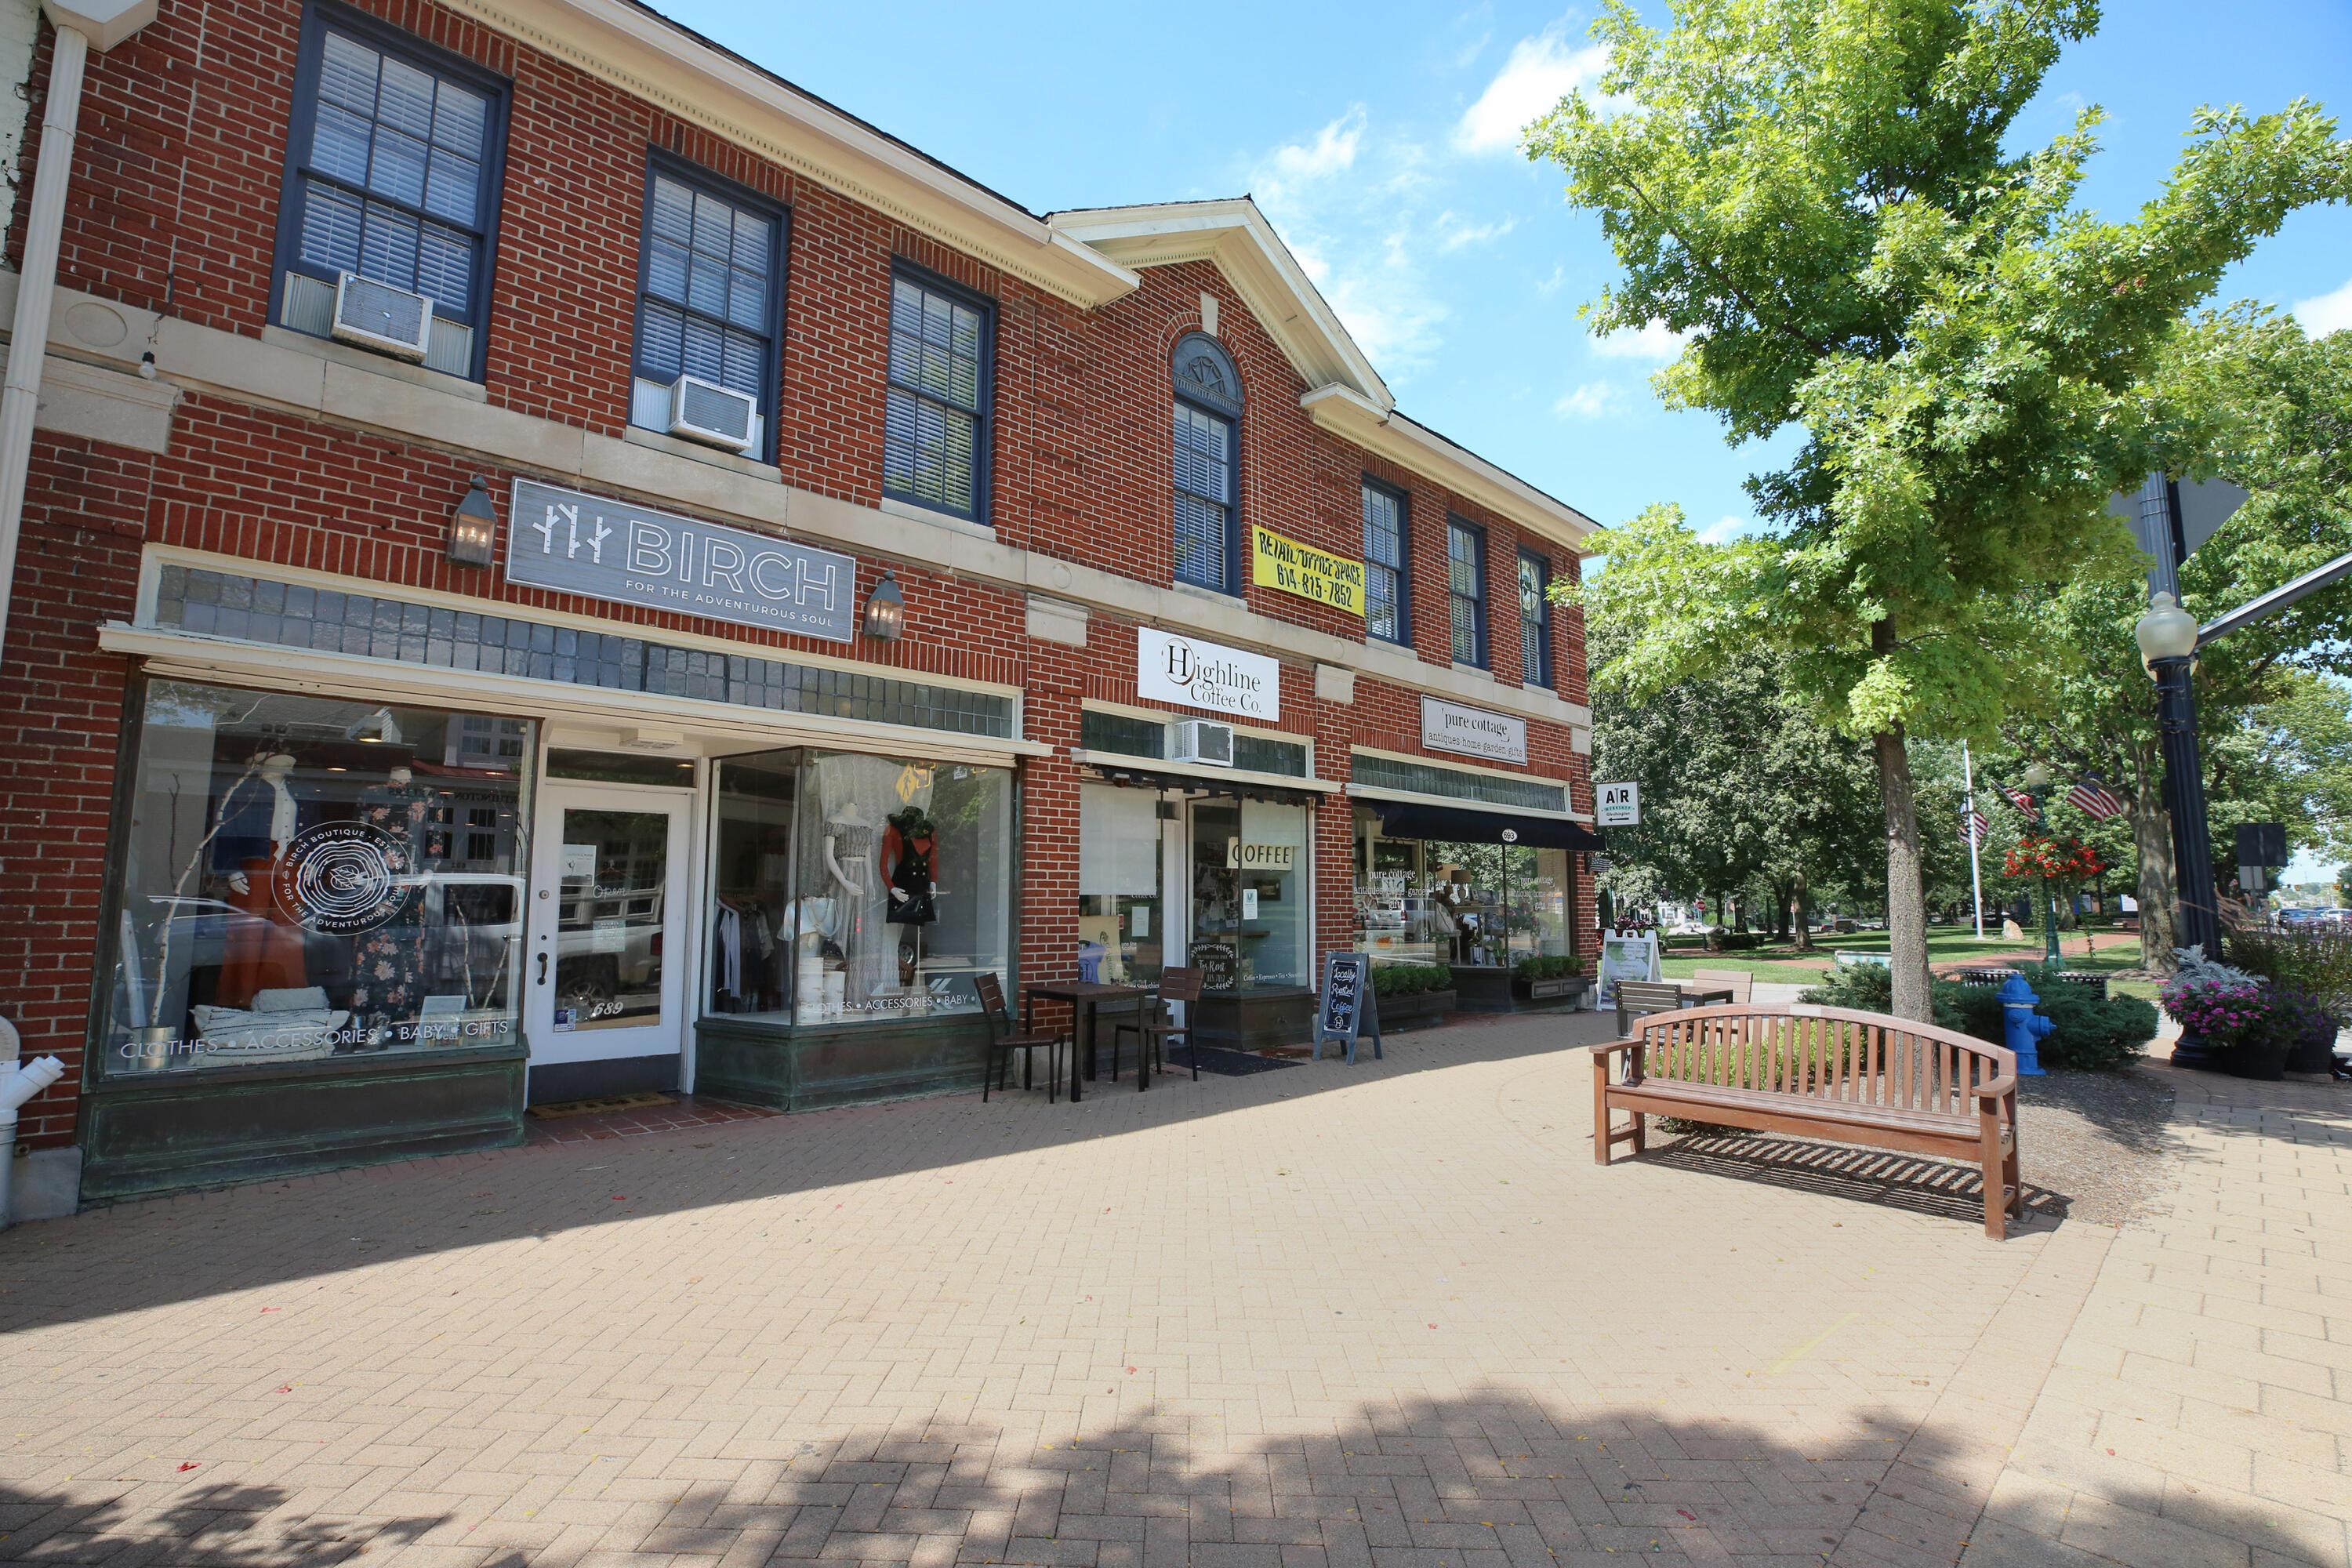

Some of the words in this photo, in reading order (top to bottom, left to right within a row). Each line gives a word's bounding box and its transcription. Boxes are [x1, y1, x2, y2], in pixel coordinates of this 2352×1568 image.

[627, 520, 836, 611] BIRCH
[1334, 560, 1361, 586] SPACE
[1277, 564, 1352, 608] 614-815-7852
[626, 580, 655, 593] FOR
[662, 586, 689, 600] THE
[695, 593, 796, 620] ADVENTUROUS
[801, 614, 833, 627] SOUL
[1167, 644, 1261, 691] Highline
[1191, 684, 1236, 707] Coffee
[1240, 693, 1261, 713] Co.
[1445, 713, 1469, 729] pure
[1472, 719, 1508, 737] cottage
[1428, 731, 1460, 746] antiques
[1462, 737, 1481, 750] home
[1483, 742, 1505, 753] garden
[1508, 747, 1523, 757] gifts
[286, 842, 309, 868] BIRCH
[310, 829, 366, 844] BOUTIQUE
[374, 837, 390, 851] EST
[1232, 844, 1289, 864] COFFEE
[1369, 870, 1387, 882] pure
[1388, 869, 1416, 880] cottage
[282, 883, 294, 902] FOR
[292, 902, 309, 918] THE
[310, 907, 387, 928] ADVENTUROUS
[593, 885, 628, 900] Open
[1334, 967, 1356, 982] Locally
[865, 996, 933, 1010] ACCESSORIES
[944, 994, 967, 1006] BABY
[1331, 983, 1354, 997] Roasted
[593, 1002, 624, 1015] 689
[1331, 998, 1353, 1015] Coffee
[120, 1038, 218, 1058] CLOTHES
[245, 1028, 376, 1050] ACCESSORIES
[400, 1025, 444, 1040] BABY
[465, 1021, 508, 1036] GIFTS
